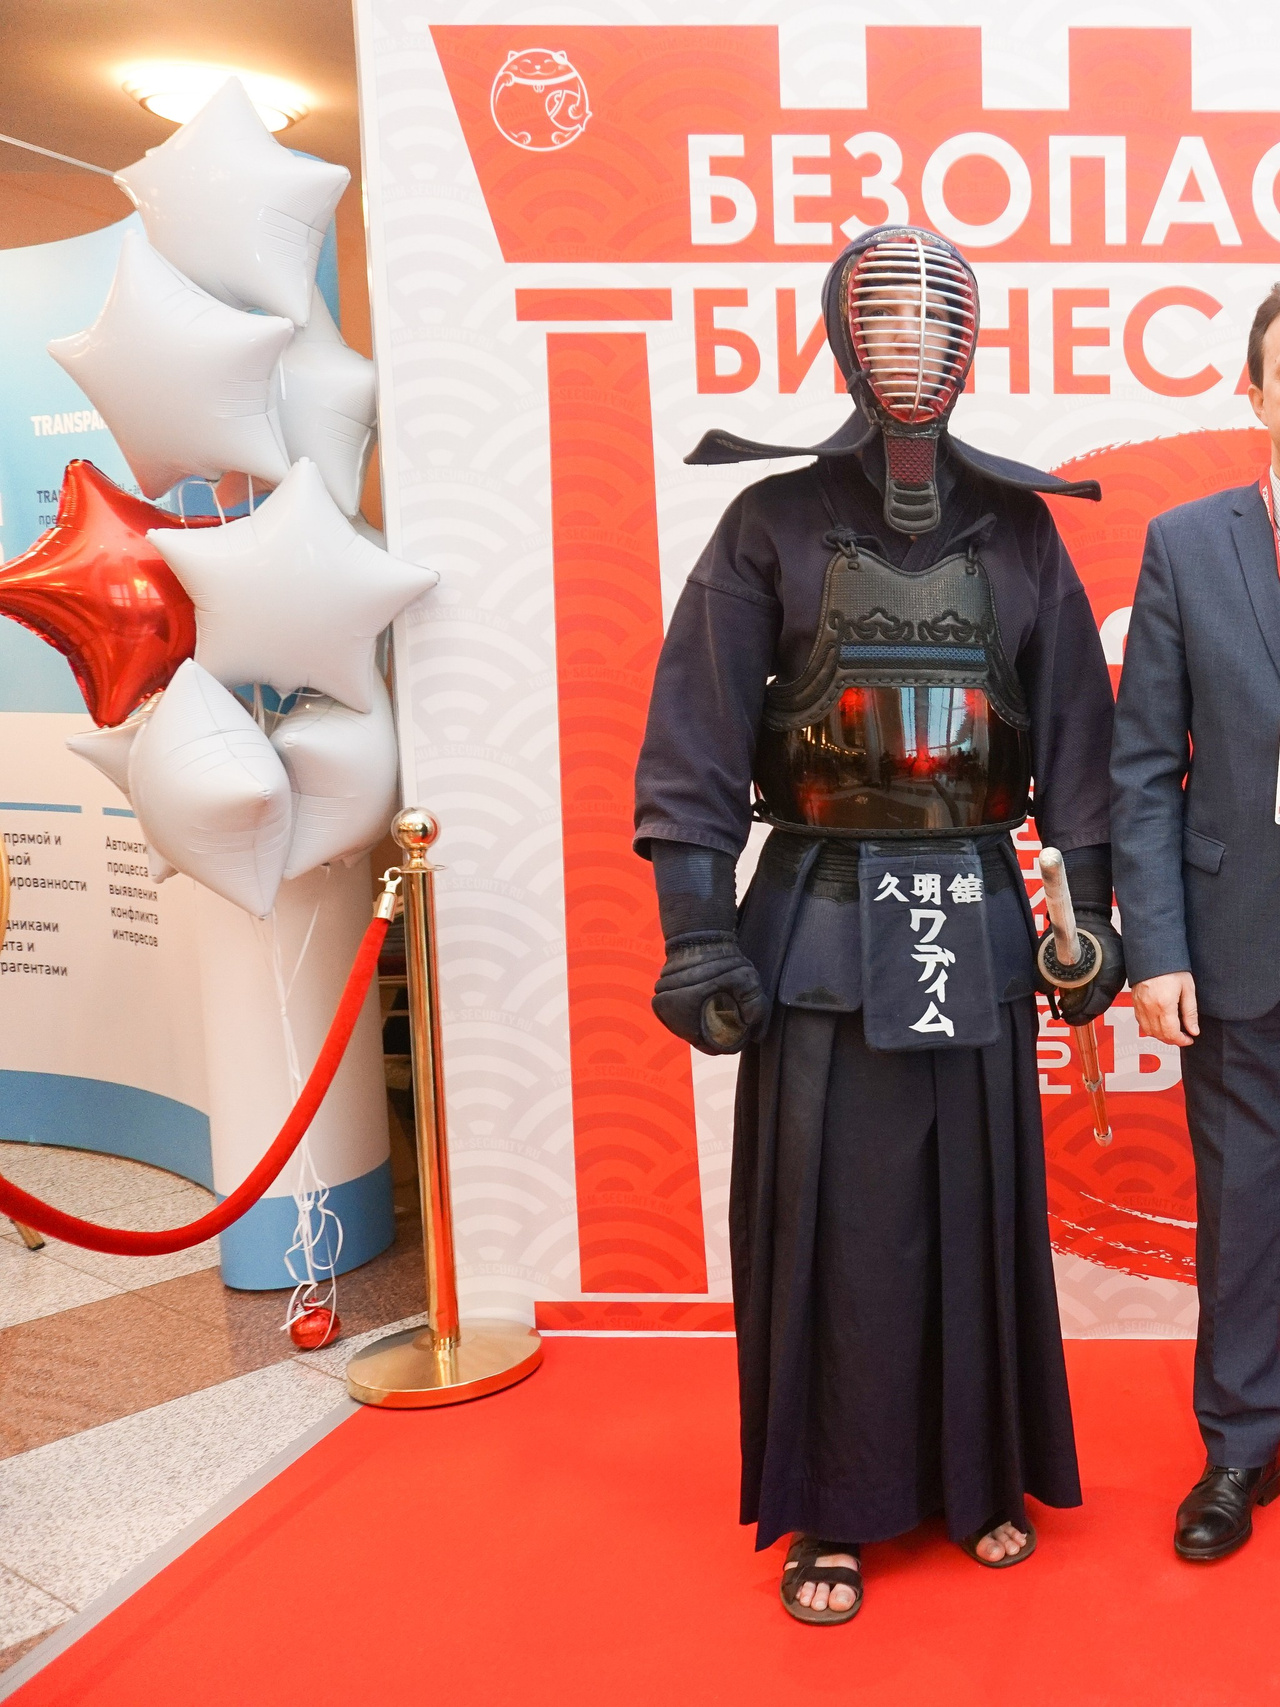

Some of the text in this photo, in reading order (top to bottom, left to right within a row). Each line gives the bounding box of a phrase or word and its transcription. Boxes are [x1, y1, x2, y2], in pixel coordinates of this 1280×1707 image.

[30, 410, 108, 436] TRANSPA
[3, 831, 62, 846] прямой и
[107, 862, 148, 877] процесса
[109, 884, 158, 902] выявления
[110, 906, 159, 925] конфликта
[112, 928, 158, 947] интересов
[27, 942, 34, 952] и
[0, 962, 68, 976] рагентами
